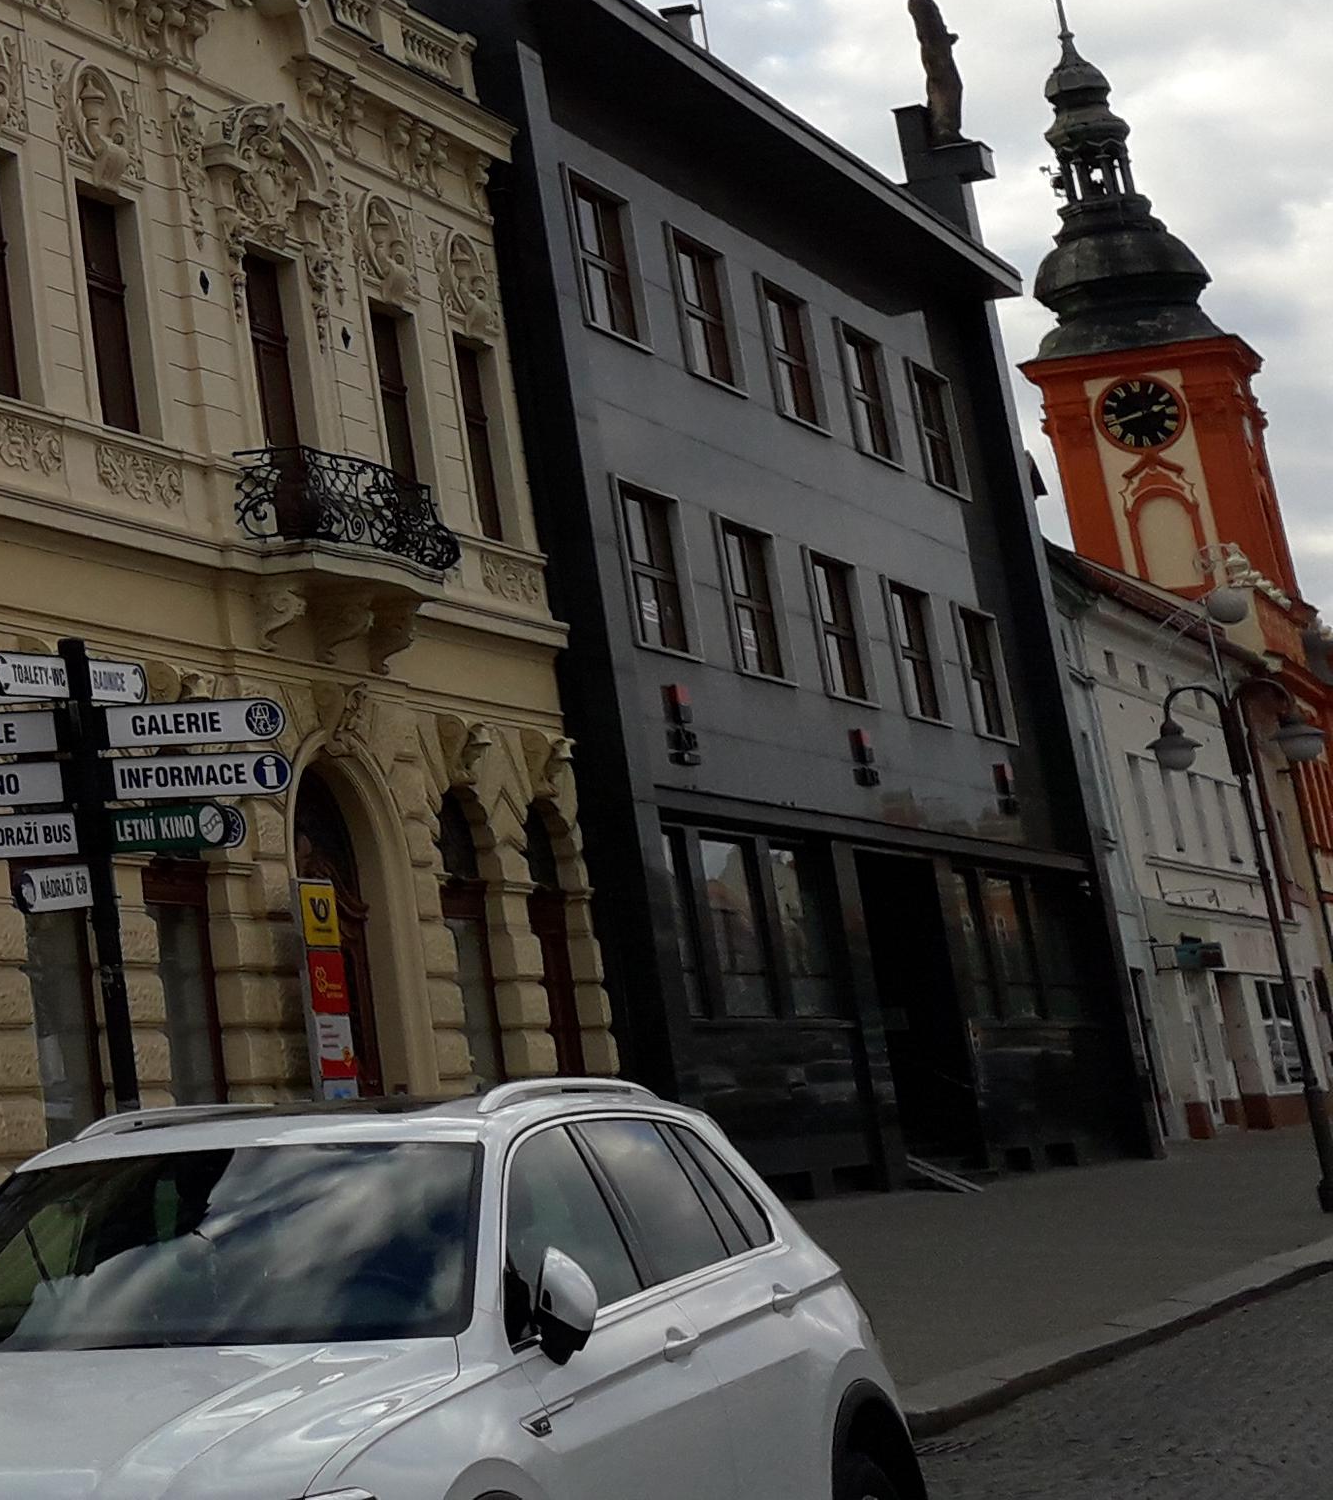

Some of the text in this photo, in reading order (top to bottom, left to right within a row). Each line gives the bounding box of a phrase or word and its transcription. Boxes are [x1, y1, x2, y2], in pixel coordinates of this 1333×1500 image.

[11, 664, 66, 687] TOALETY-WC
[131, 712, 222, 736] GALERIE
[120, 763, 247, 789] INFORMACE
[42, 824, 72, 844] BUS
[115, 812, 196, 842] LETNÍ KINO
